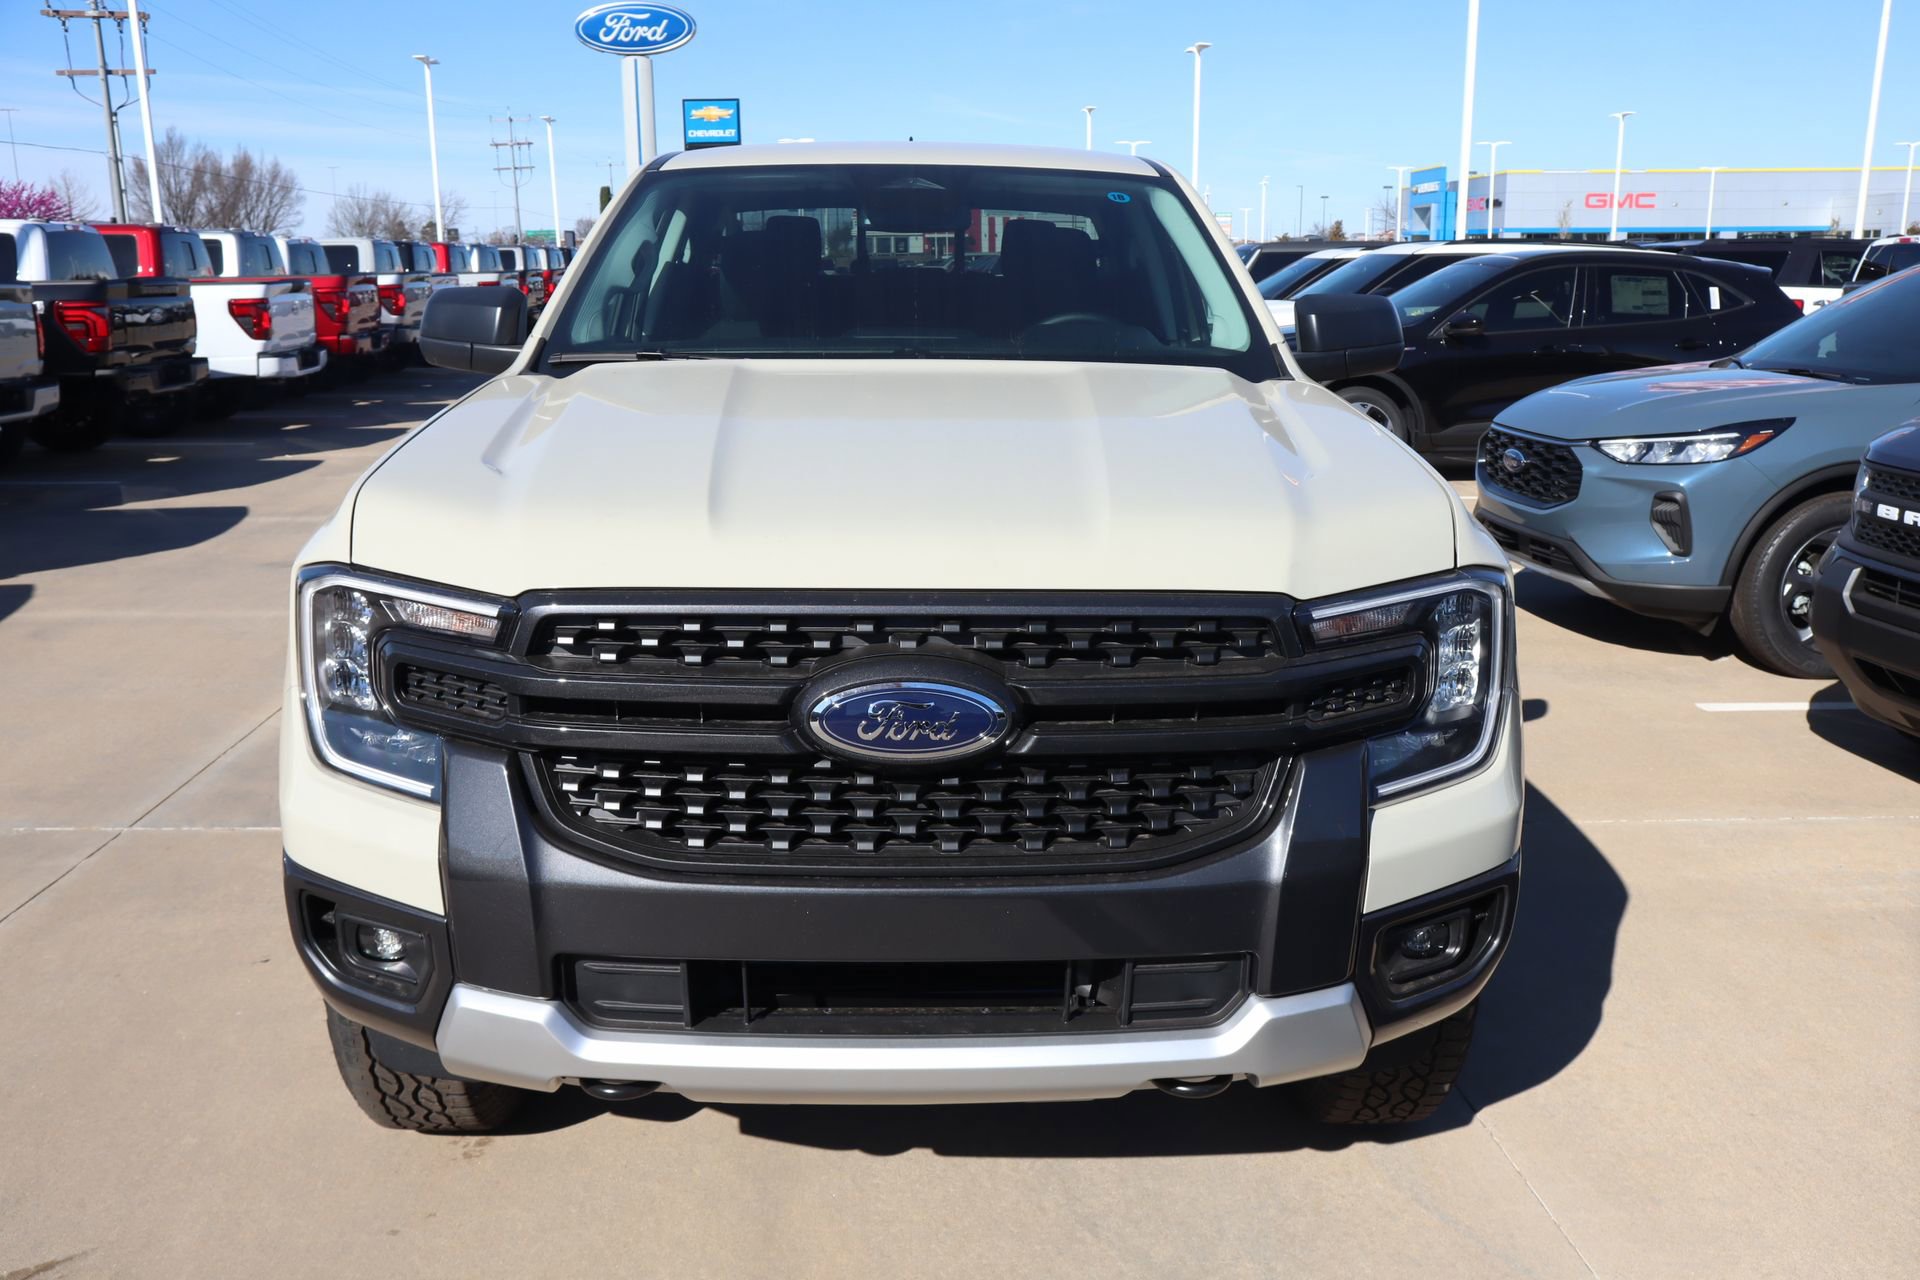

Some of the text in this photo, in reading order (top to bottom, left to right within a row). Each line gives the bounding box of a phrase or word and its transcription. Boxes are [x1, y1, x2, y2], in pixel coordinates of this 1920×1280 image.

[599, 12, 669, 42] Ford
[688, 129, 736, 137] CHEVROLET
[1585, 192, 1656, 208] GMC
[1877, 503, 1920, 527] BR
[857, 699, 960, 741] Ford
